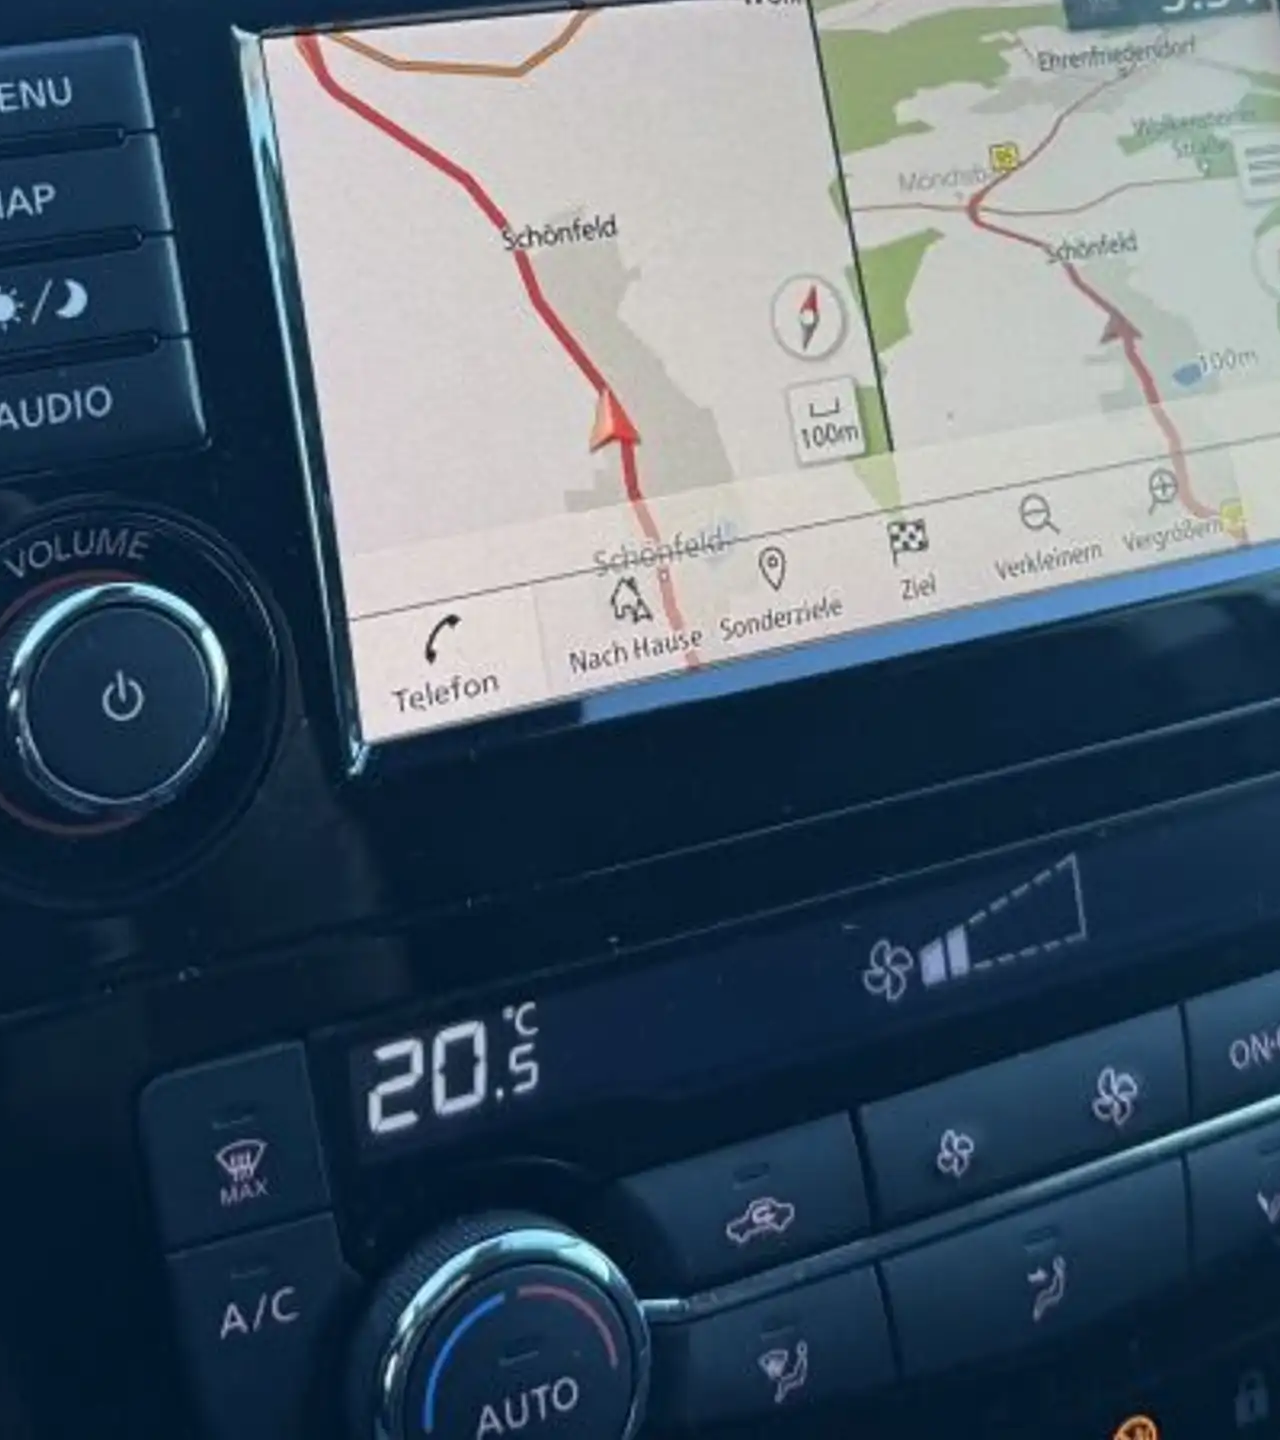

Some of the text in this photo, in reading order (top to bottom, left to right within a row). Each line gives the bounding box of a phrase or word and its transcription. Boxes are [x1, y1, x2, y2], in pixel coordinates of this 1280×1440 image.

[501, 214, 619, 252] Schönfeld
[1044, 228, 1139, 265] Schönfeld
[1200, 348, 1260, 373] 100m
[800, 422, 860, 451] 100m
[4, 527, 151, 578] VOLUME
[1122, 518, 1224, 555] Vergrößern
[994, 541, 1103, 582] Verkleinern
[901, 572, 937, 602] Ziel
[720, 596, 844, 642] Sonderziele
[569, 629, 704, 675] Nach Hause
[391, 674, 500, 713] Telefon
[219, 1178, 269, 1207] MAX
[219, 1286, 301, 1341] A/C
[475, 1375, 580, 1440] AUTO
